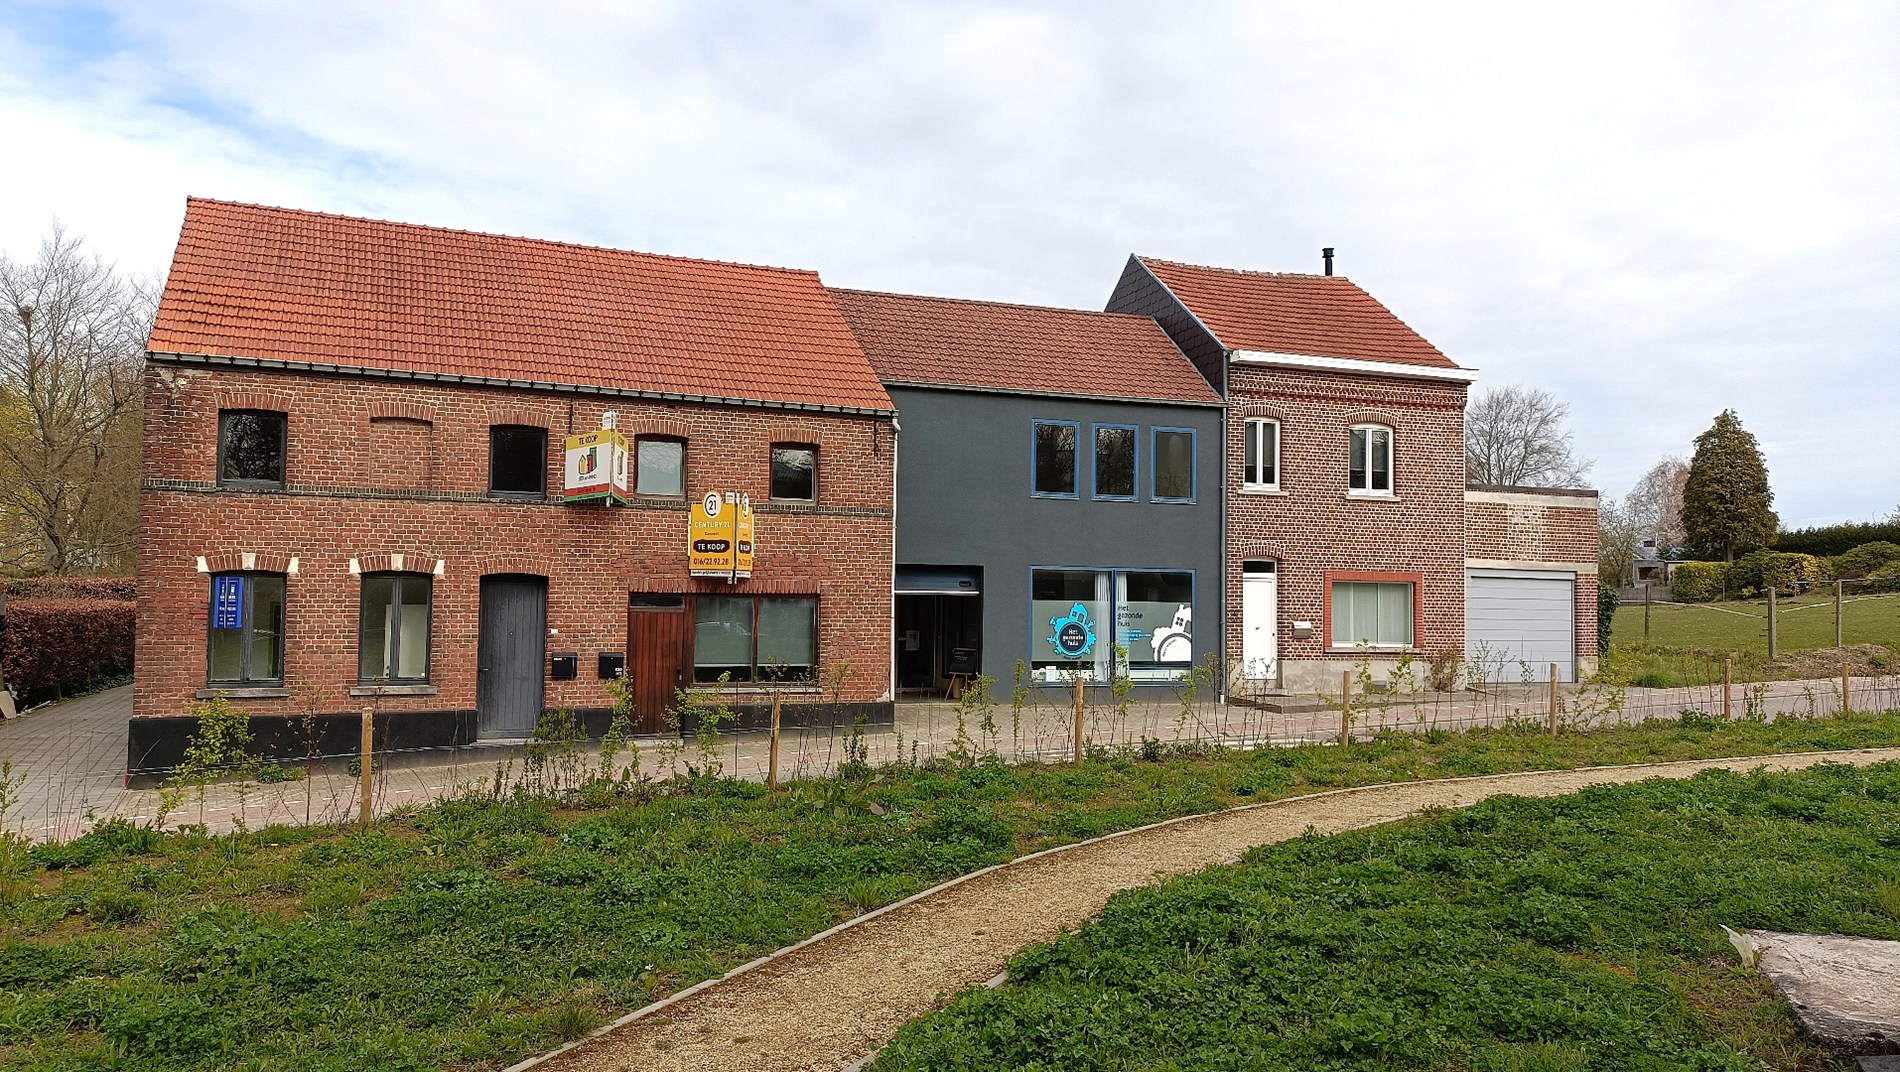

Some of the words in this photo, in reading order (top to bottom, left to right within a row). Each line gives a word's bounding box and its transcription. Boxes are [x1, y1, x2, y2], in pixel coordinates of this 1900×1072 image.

[578, 437, 584, 445] TE
[693, 558, 729, 566] 016/22.92.28
[1117, 612, 1143, 620] gezonde
